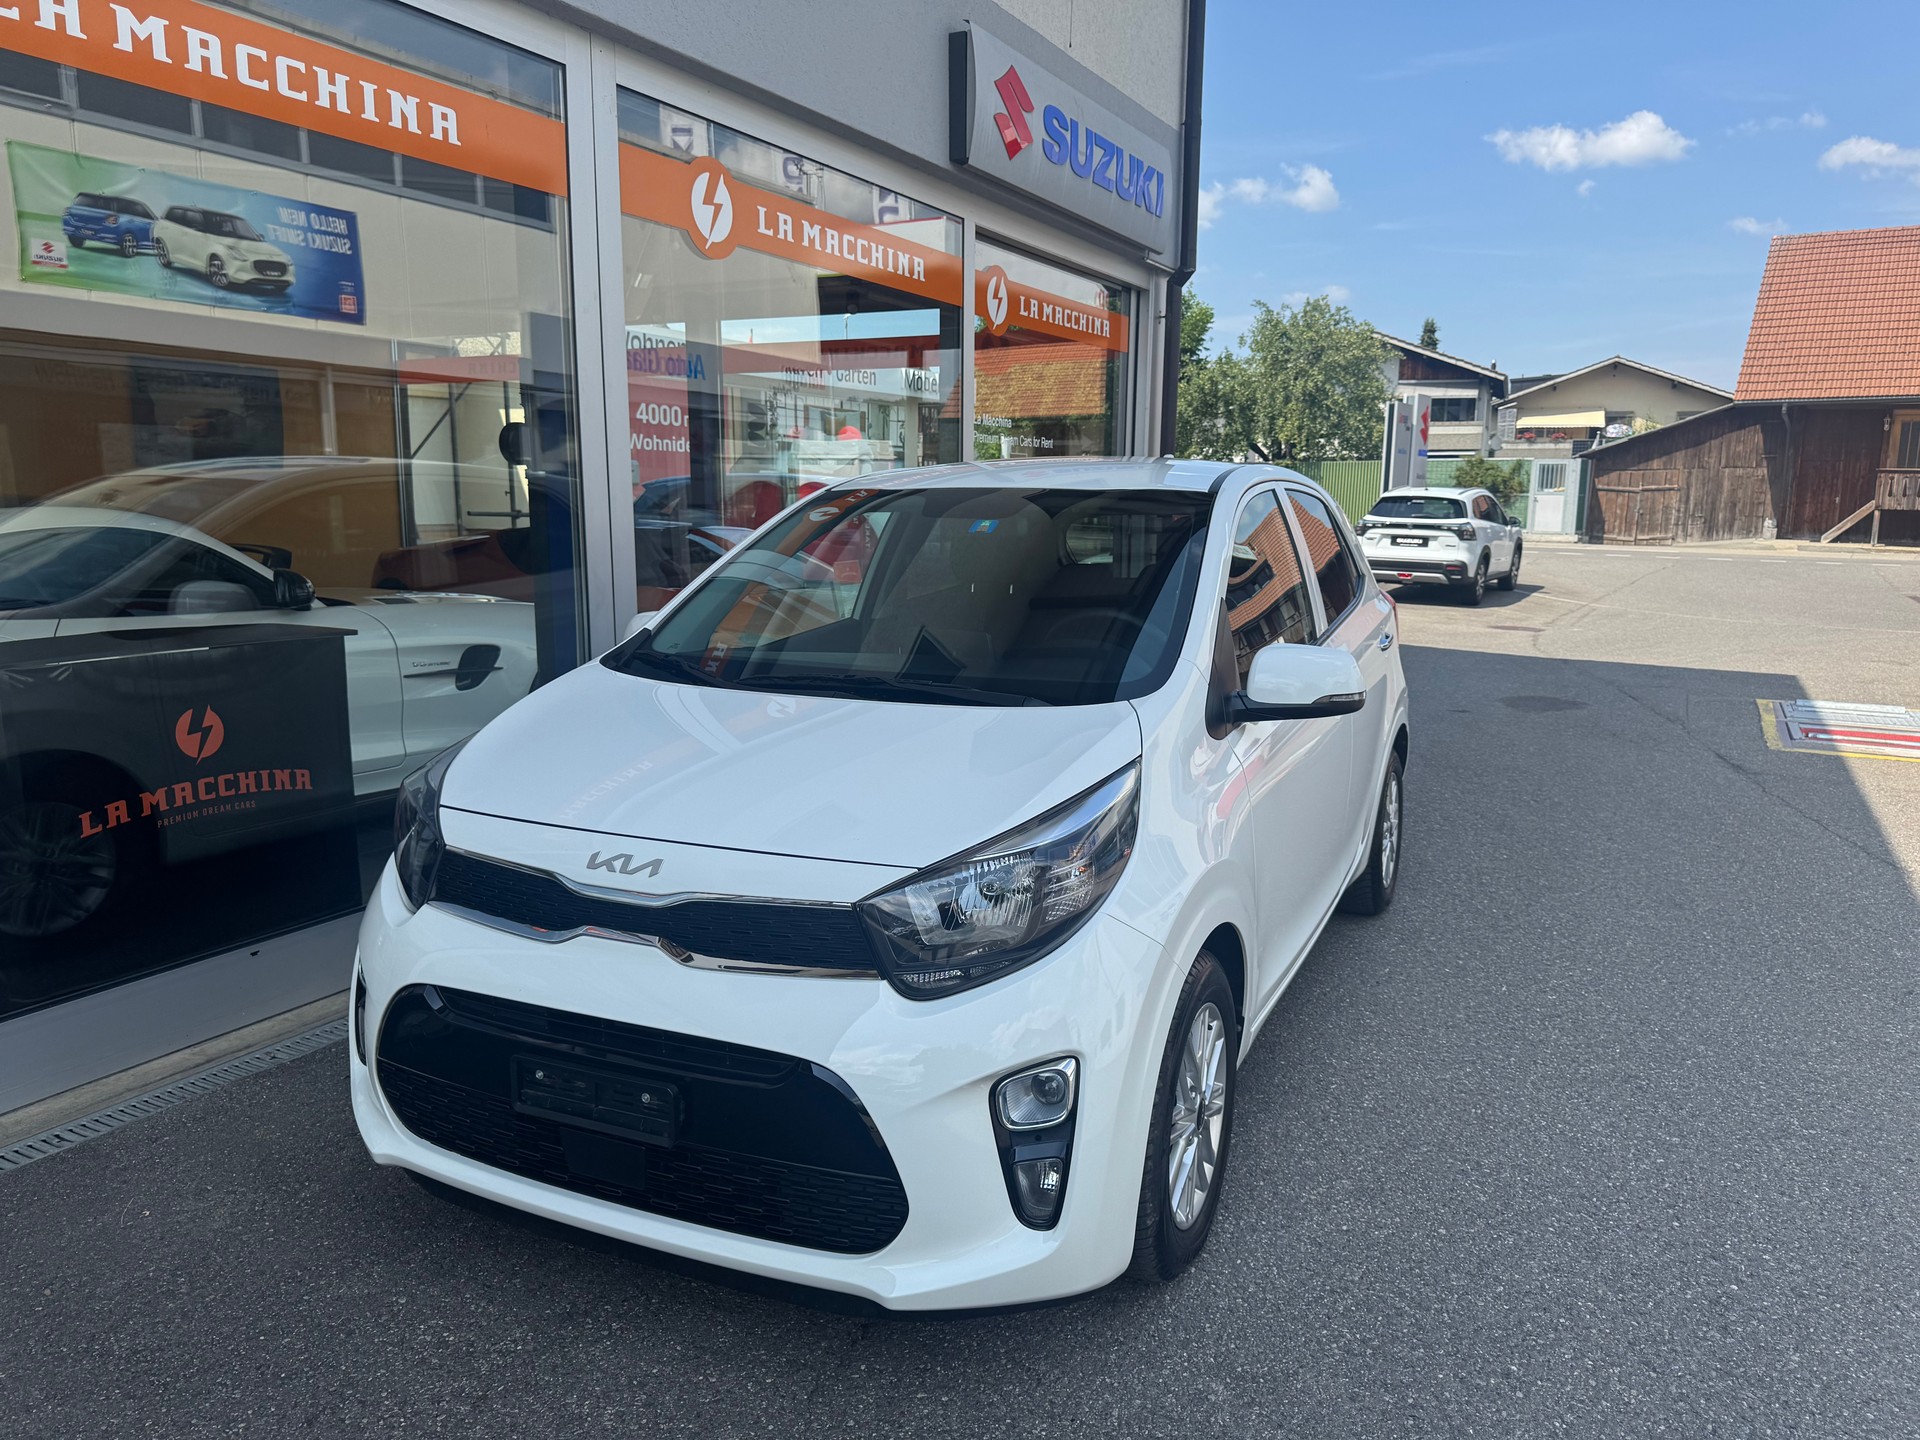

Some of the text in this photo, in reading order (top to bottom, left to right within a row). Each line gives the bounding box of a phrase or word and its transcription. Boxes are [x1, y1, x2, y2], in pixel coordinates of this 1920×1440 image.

[0, 0, 461, 146] A MACCHINA
[1042, 104, 1164, 218] SUZUKI
[757, 205, 926, 282] LA MACCHINA
[1019, 295, 1110, 338] LA MACCHINA
[635, 402, 682, 427] 4000
[982, 413, 1012, 428] Macchina
[1020, 435, 1033, 448] Cars
[1033, 436, 1041, 448] for
[1041, 437, 1054, 449] Rent
[78, 768, 313, 839] LA MACCHINA
[157, 800, 257, 829] PREMIUM DREAM CARS
[586, 850, 664, 878] KIA
